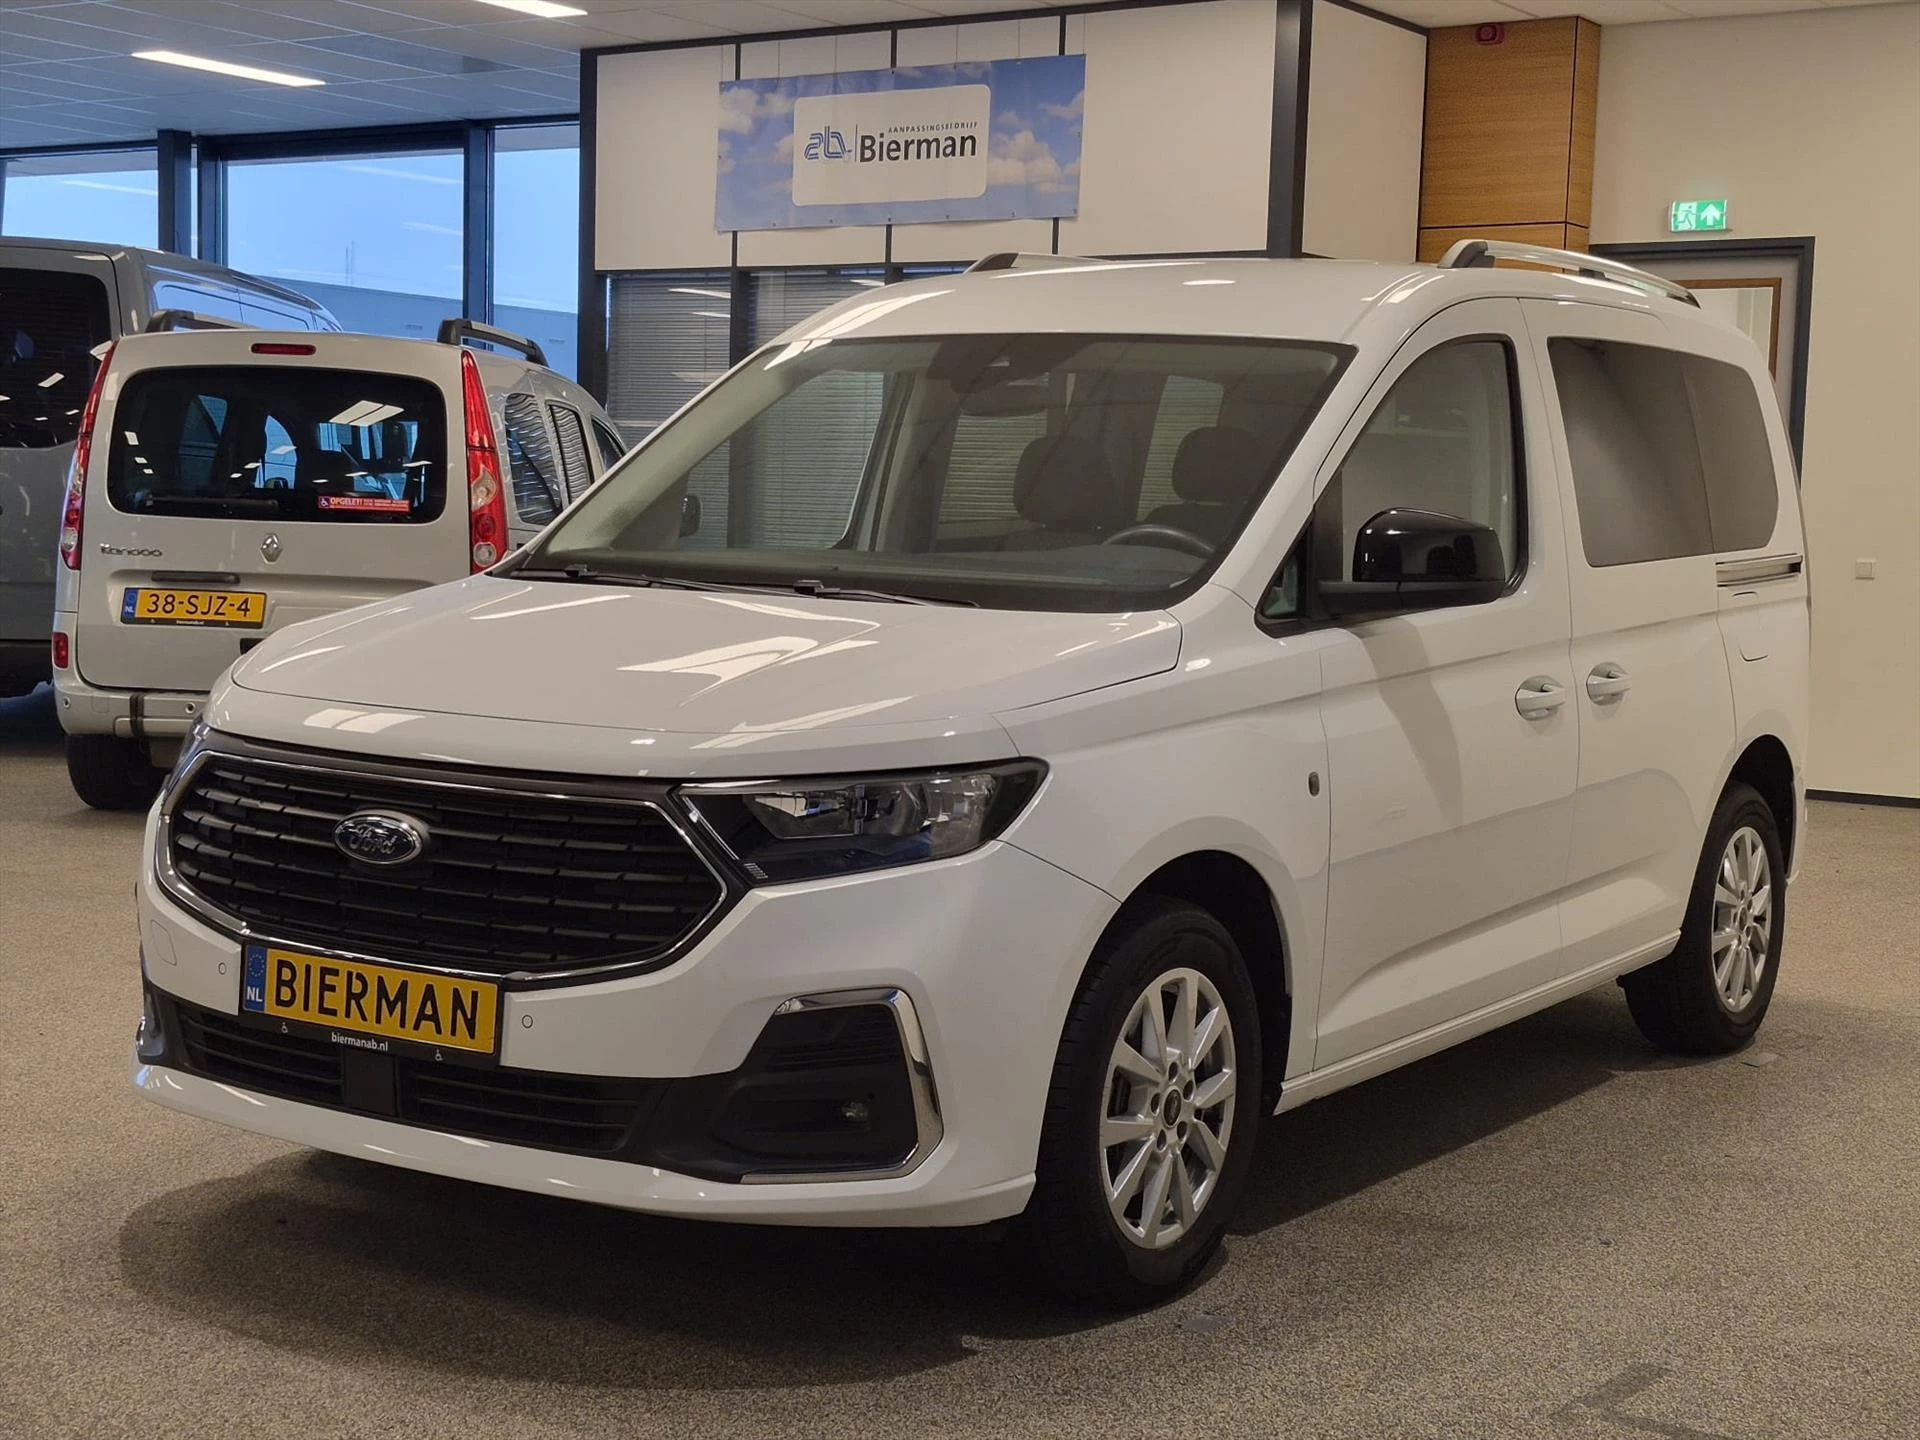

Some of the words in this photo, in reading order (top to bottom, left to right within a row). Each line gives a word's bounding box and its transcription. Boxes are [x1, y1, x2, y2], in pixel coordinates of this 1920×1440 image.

[859, 133, 978, 163] Bierman
[146, 593, 251, 617] 38-SJZ-4
[246, 985, 264, 1003] NL
[275, 959, 479, 1040] BIERMAN
[331, 1031, 389, 1052] biermanab.nl
